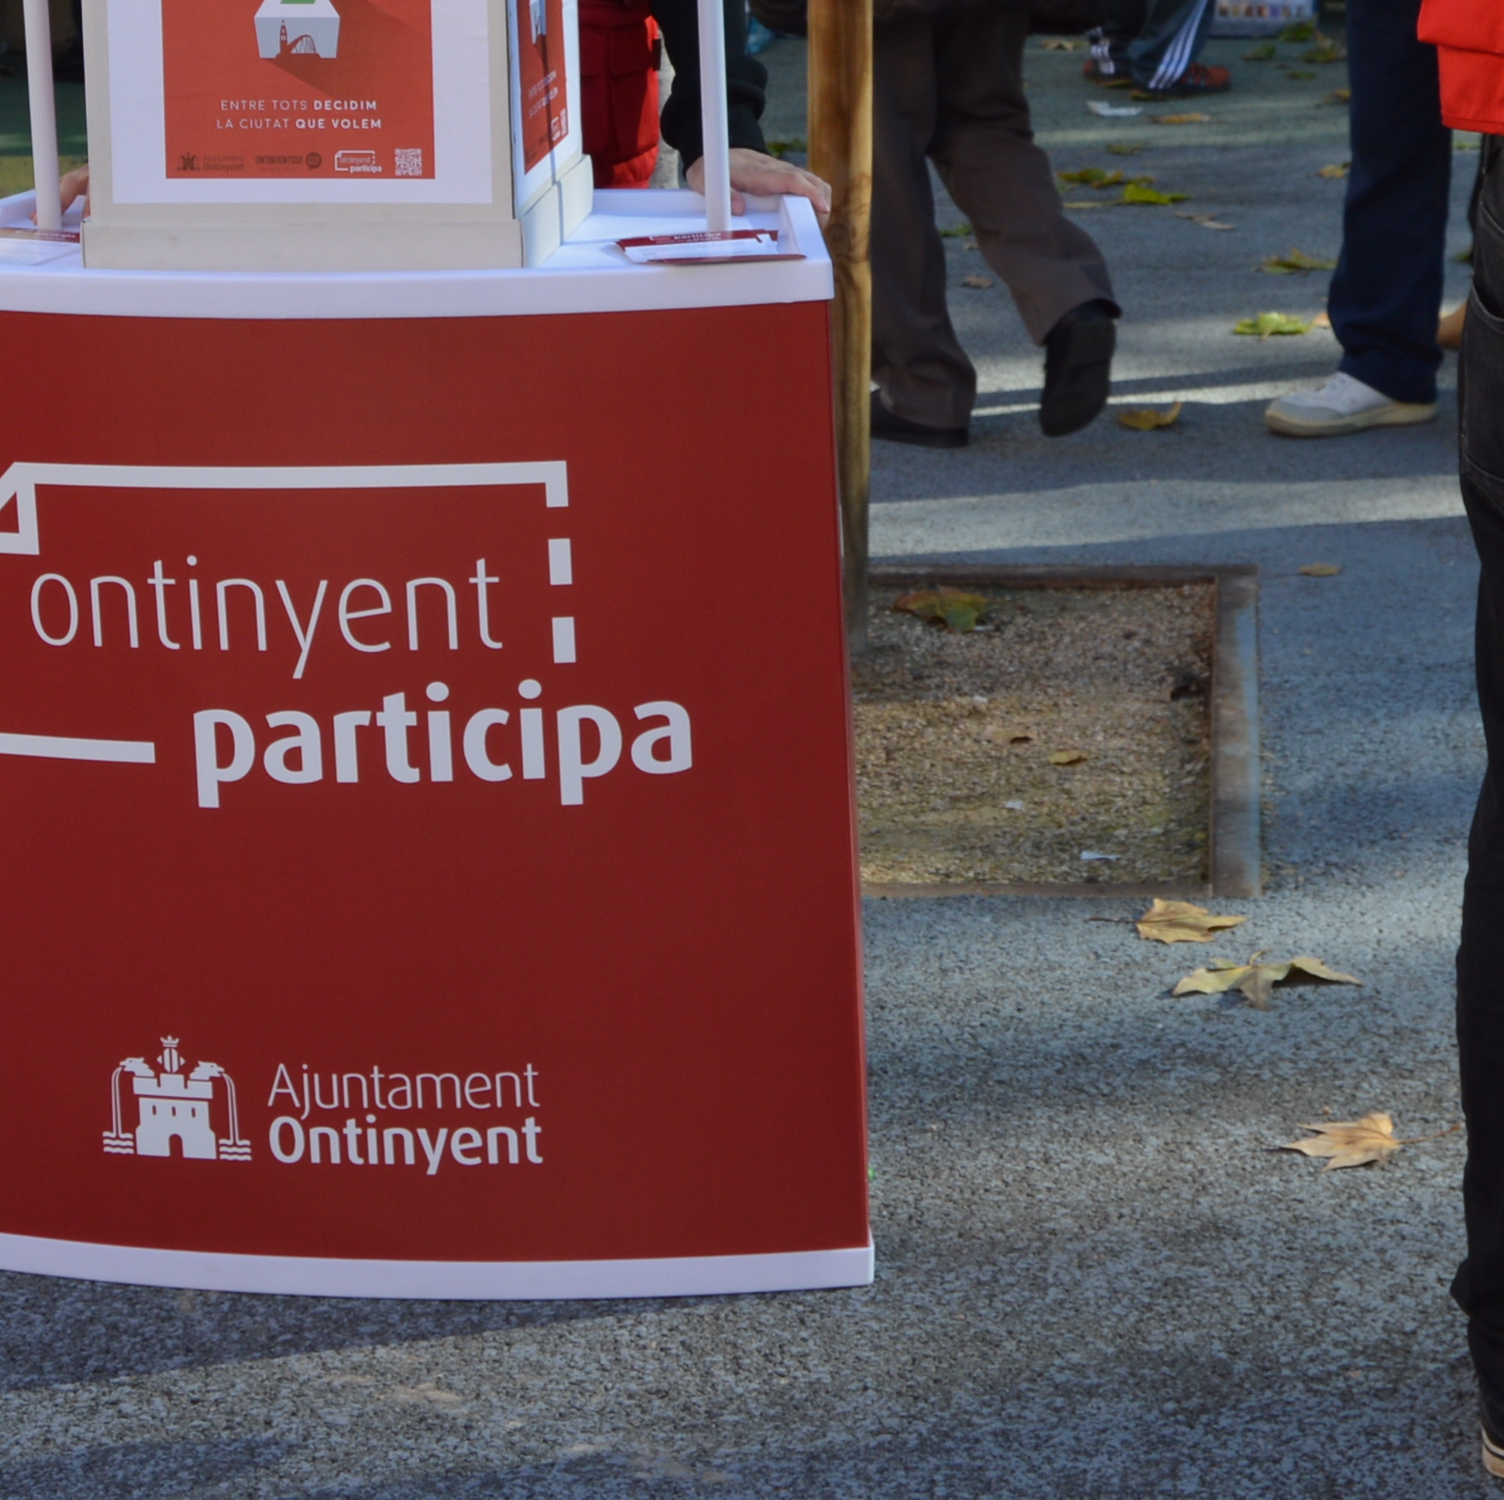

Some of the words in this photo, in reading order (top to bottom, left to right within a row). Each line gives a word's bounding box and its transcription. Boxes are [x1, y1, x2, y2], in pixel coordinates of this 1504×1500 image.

[216, 118, 234, 129] LA
[239, 118, 290, 129] CIUTAT
[295, 118, 325, 130] QUE
[331, 118, 382, 129] VOLEM
[220, 99, 265, 111] ENTRE
[271, 99, 308, 111] TOTS
[313, 99, 377, 111] DECIDIM
[349, 163, 383, 174] participa
[29, 555, 503, 680] ontinyent
[192, 678, 693, 809] participa
[267, 1062, 540, 1120] Ajuntament
[269, 1114, 544, 1176] Ontinyent
